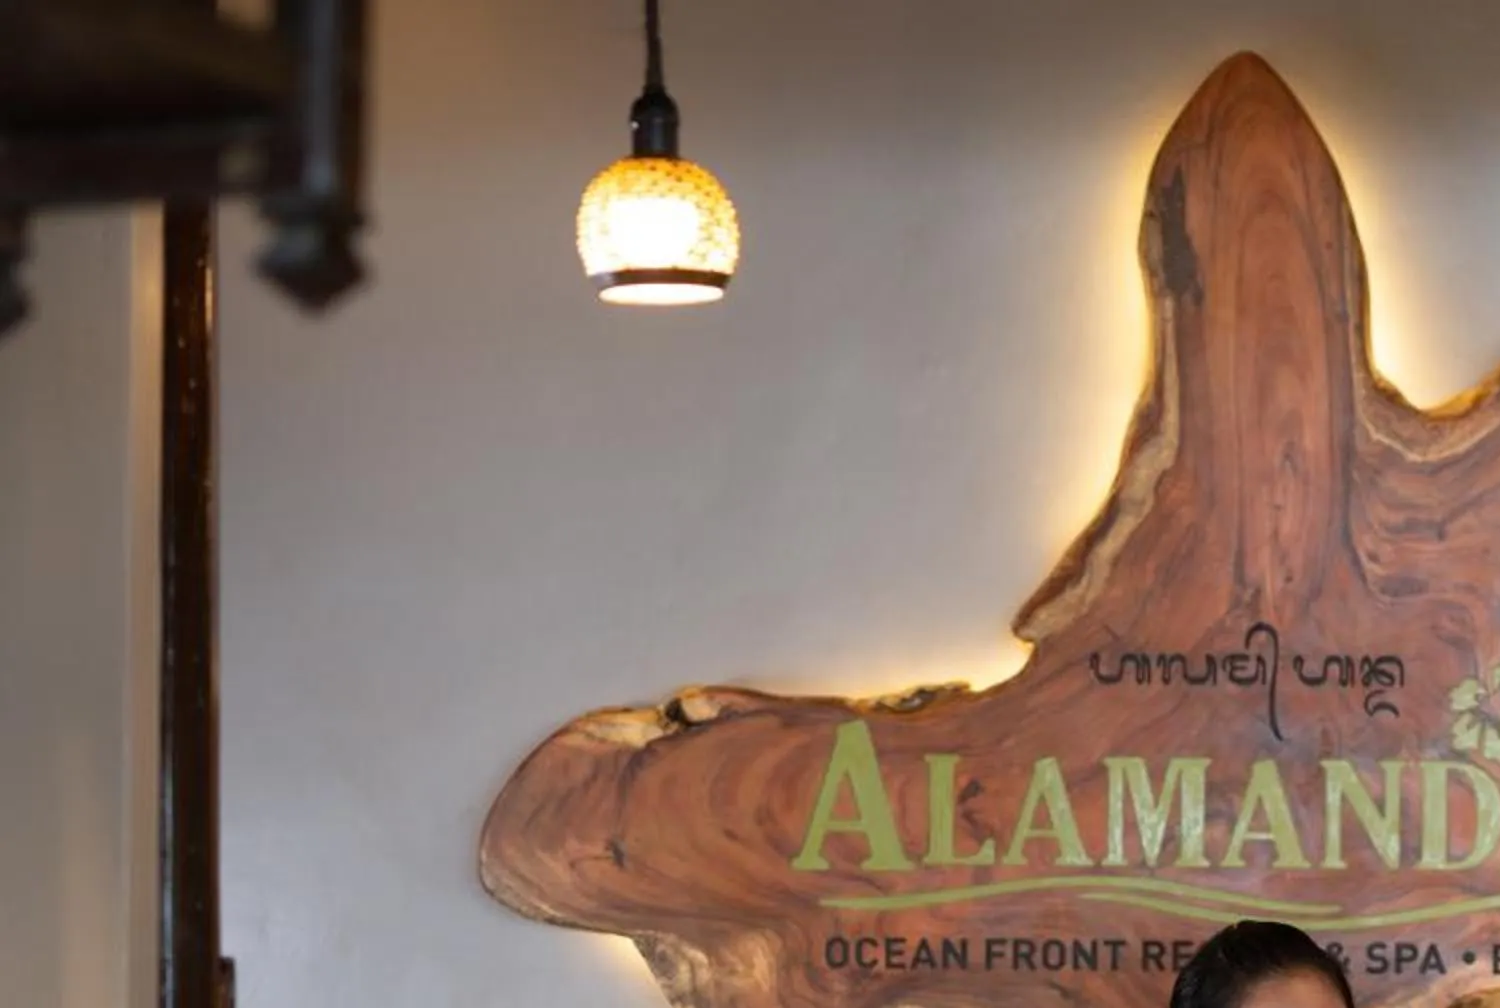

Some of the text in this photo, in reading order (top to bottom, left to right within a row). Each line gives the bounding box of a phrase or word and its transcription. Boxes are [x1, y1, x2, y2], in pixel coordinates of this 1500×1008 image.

[825, 936, 969, 970] OCEAN
[985, 938, 1127, 972] FRONT
[1366, 942, 1447, 975] SPA
